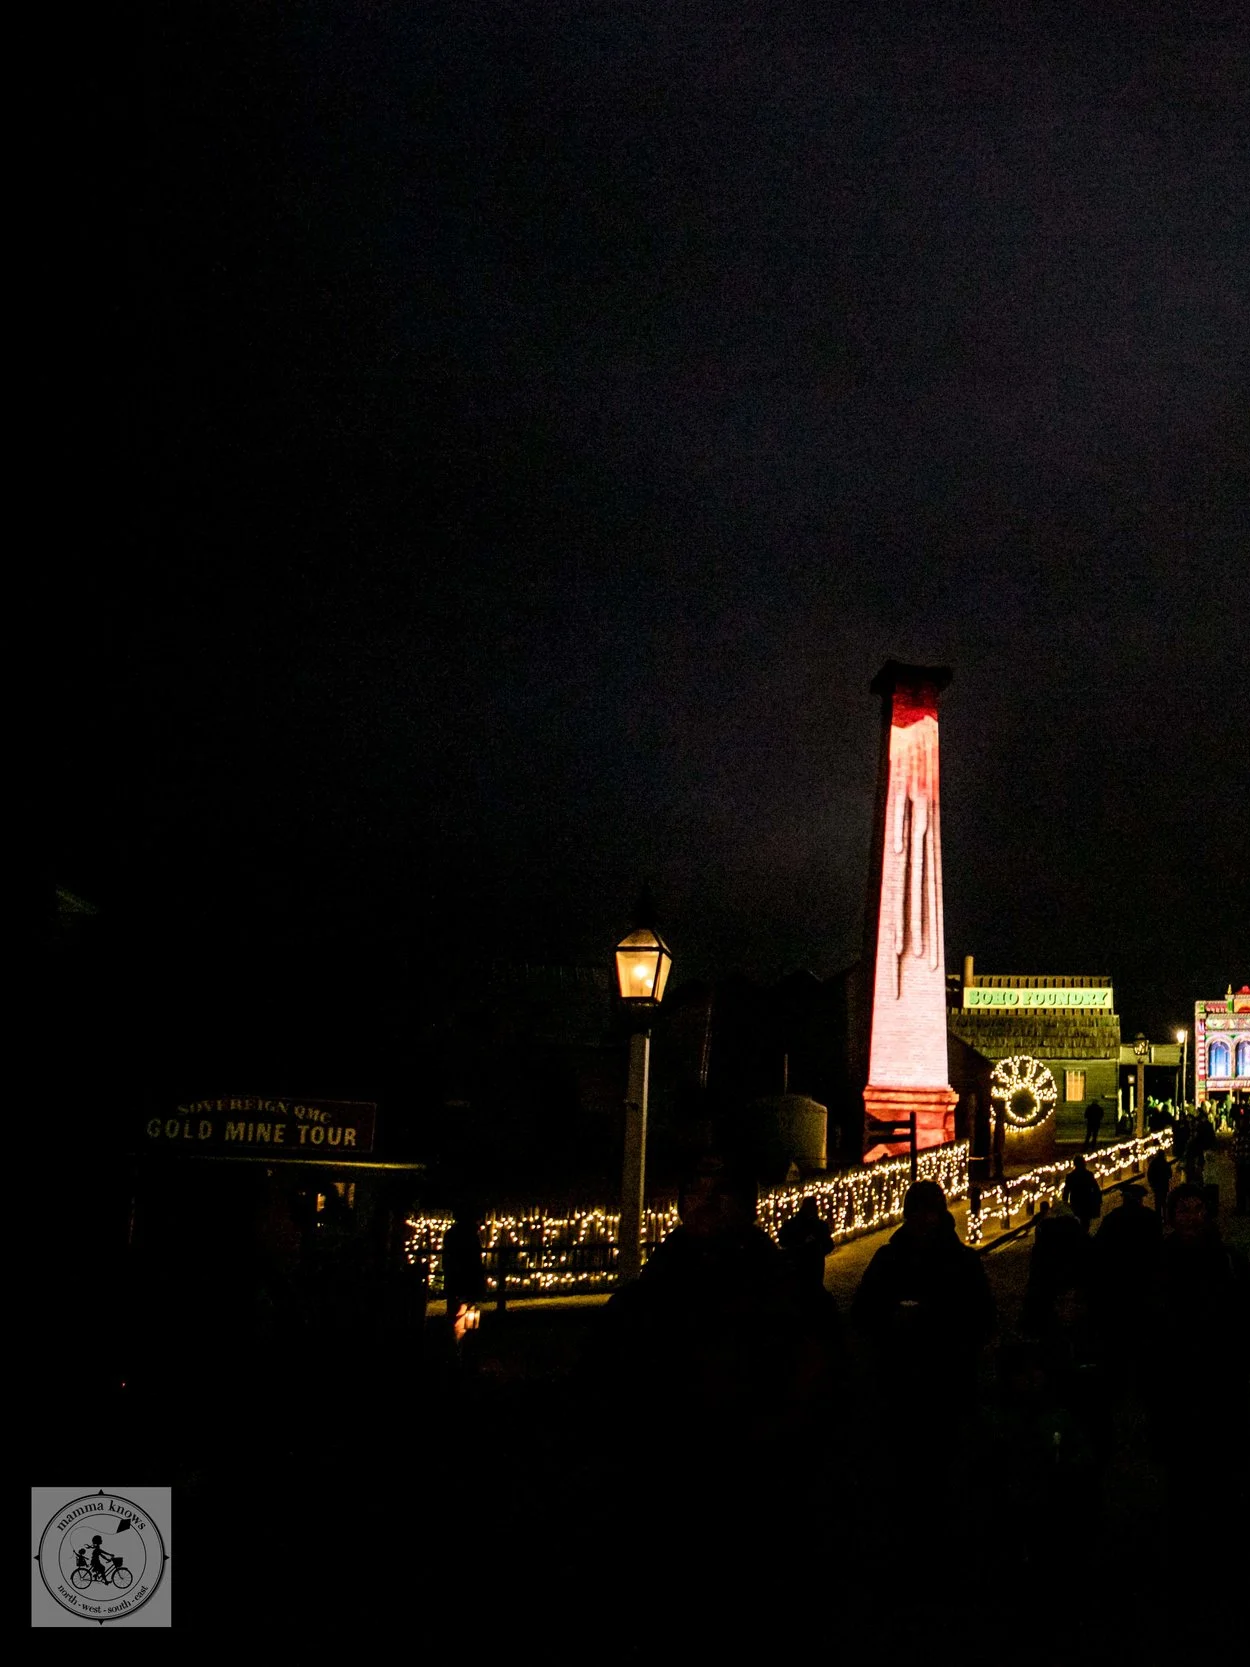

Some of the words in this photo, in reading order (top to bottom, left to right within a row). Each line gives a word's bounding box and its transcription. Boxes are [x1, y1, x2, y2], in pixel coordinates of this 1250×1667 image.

[969, 991, 1019, 1005] SOHO
[1022, 992, 1108, 1006] FOUNDRY
[176, 1098, 288, 1115] SOVEREIGN
[146, 1118, 212, 1139] GOLD
[225, 1121, 286, 1143] MINE
[297, 1125, 356, 1146] TOUR
